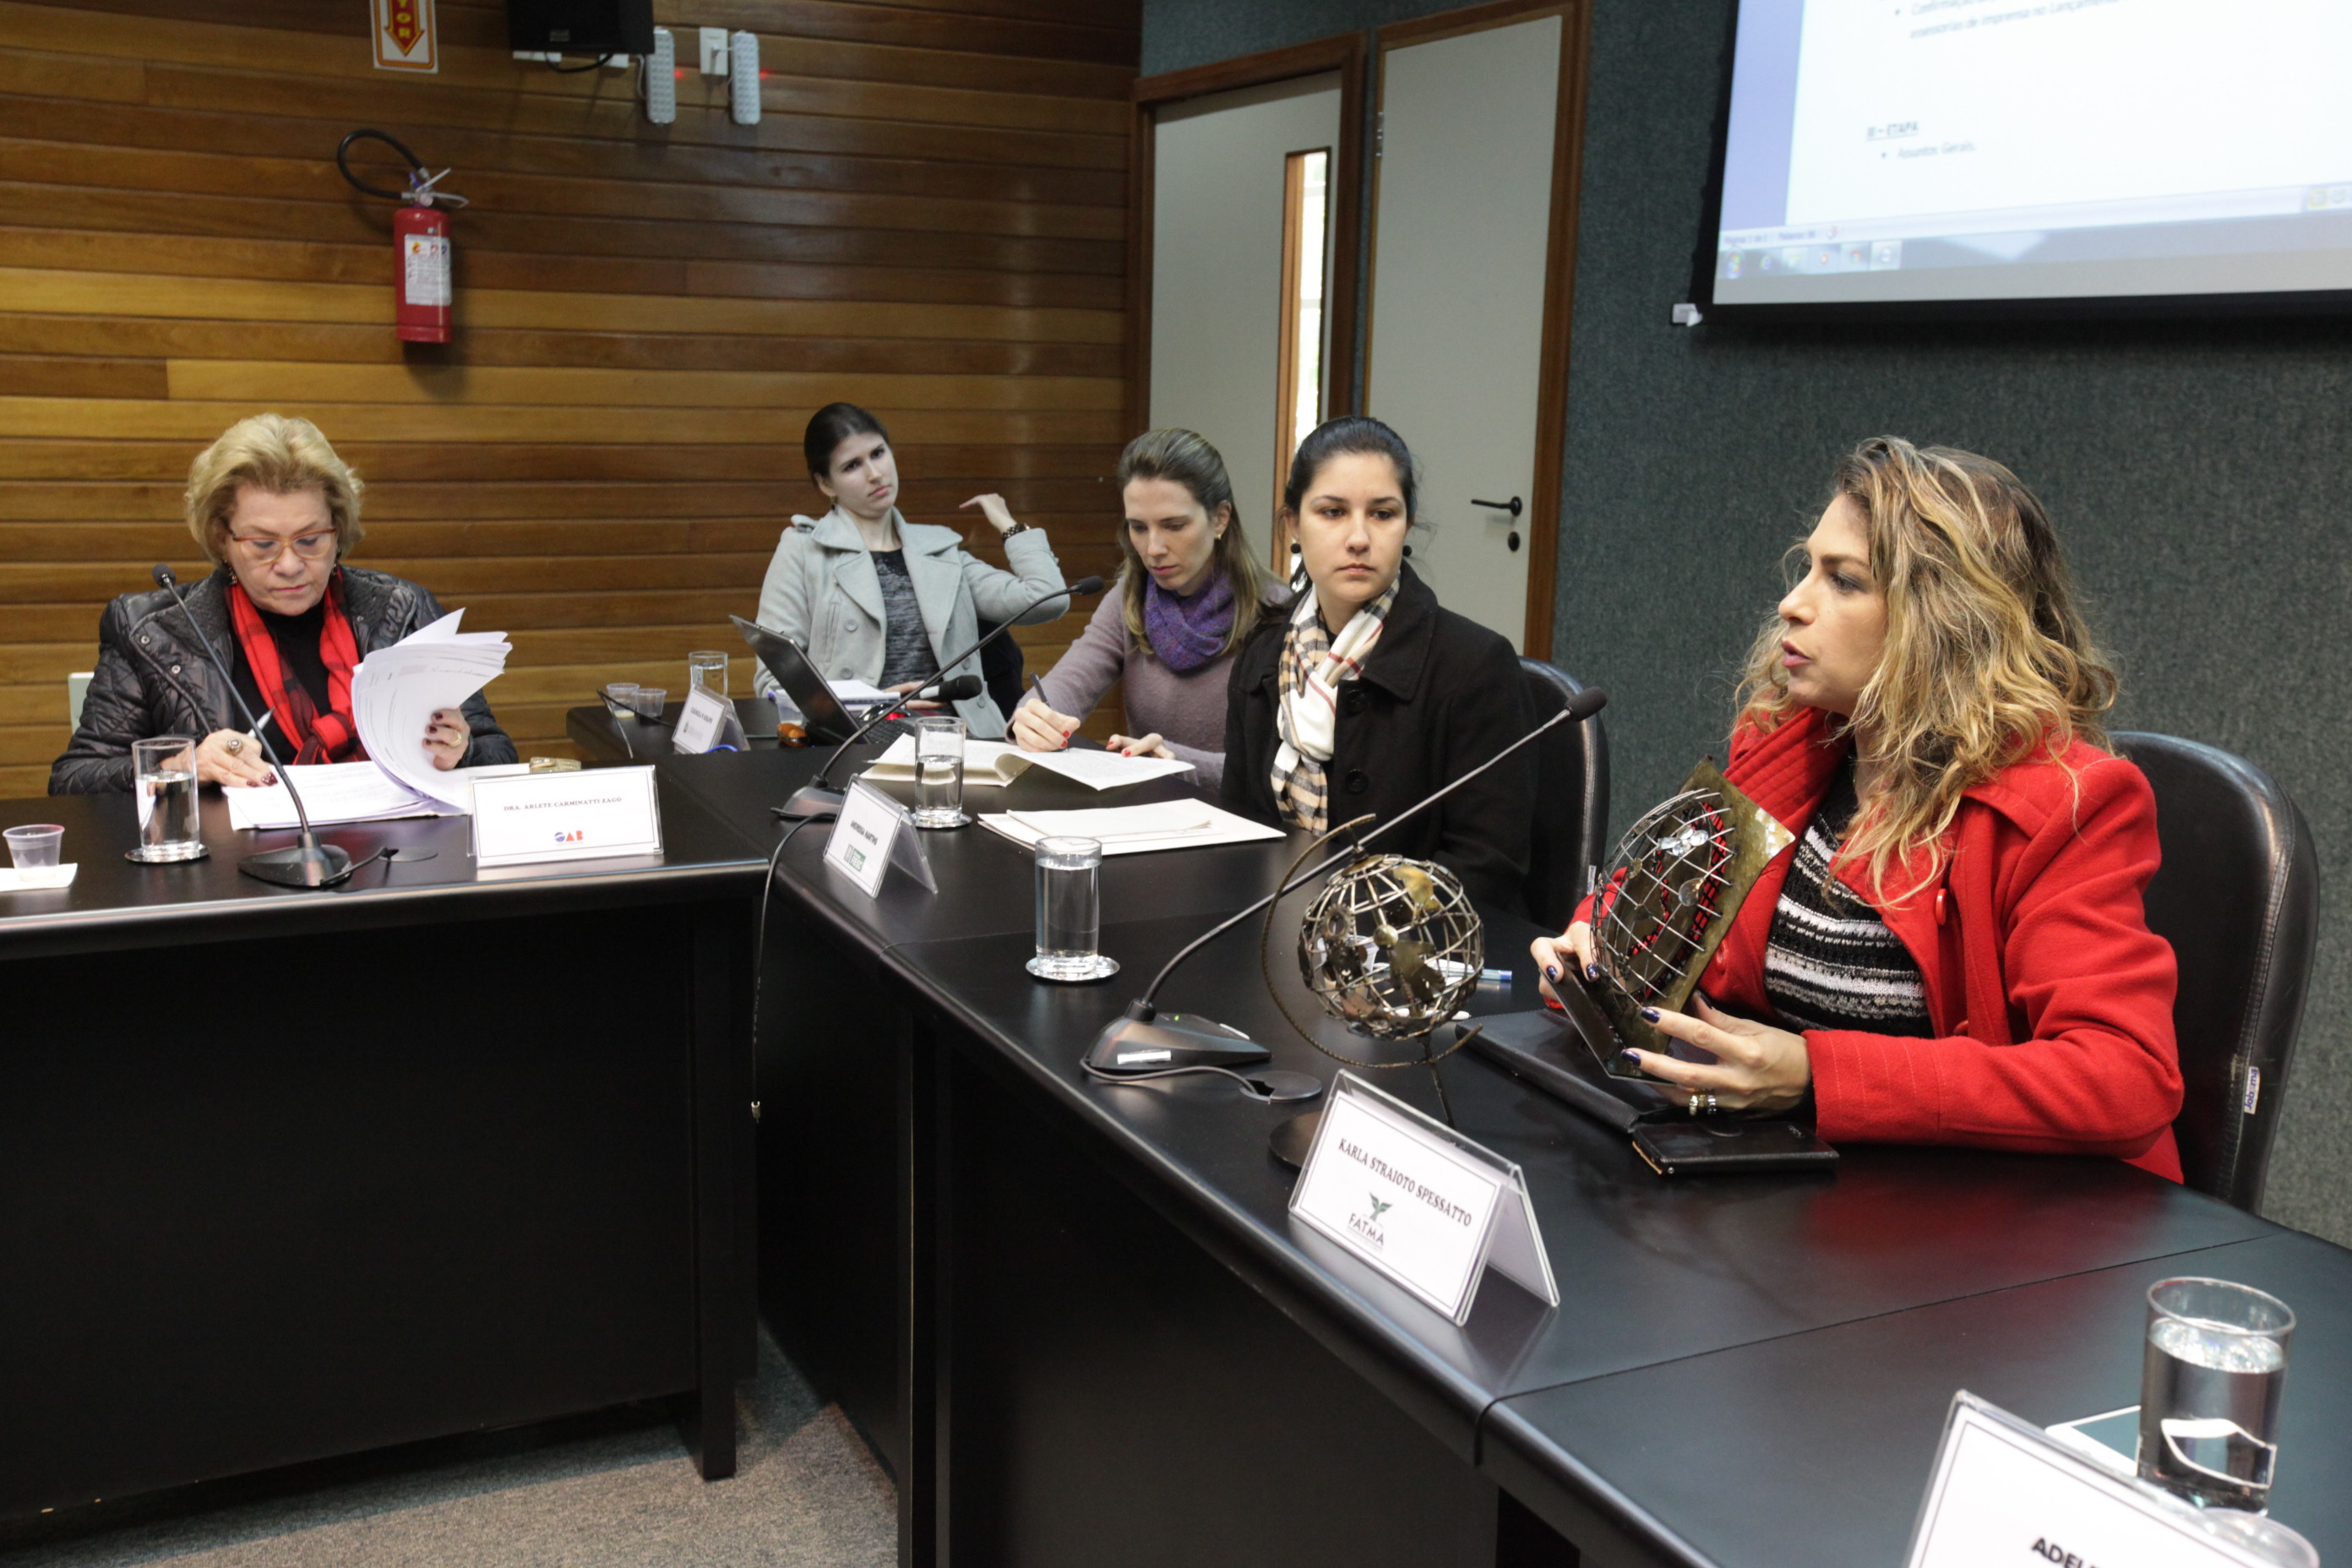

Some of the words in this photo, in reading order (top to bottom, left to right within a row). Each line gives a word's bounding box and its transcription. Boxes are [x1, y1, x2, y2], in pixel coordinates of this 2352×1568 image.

[554, 798, 601, 808] CARMINATTI
[1338, 1137, 1369, 1168] KARLA
[1369, 1156, 1416, 1193] STRAIOTO
[1416, 1184, 1473, 1228] SPESSATTO
[1348, 1212, 1384, 1246] FATMA
[2030, 1537, 2098, 1568] ADE
